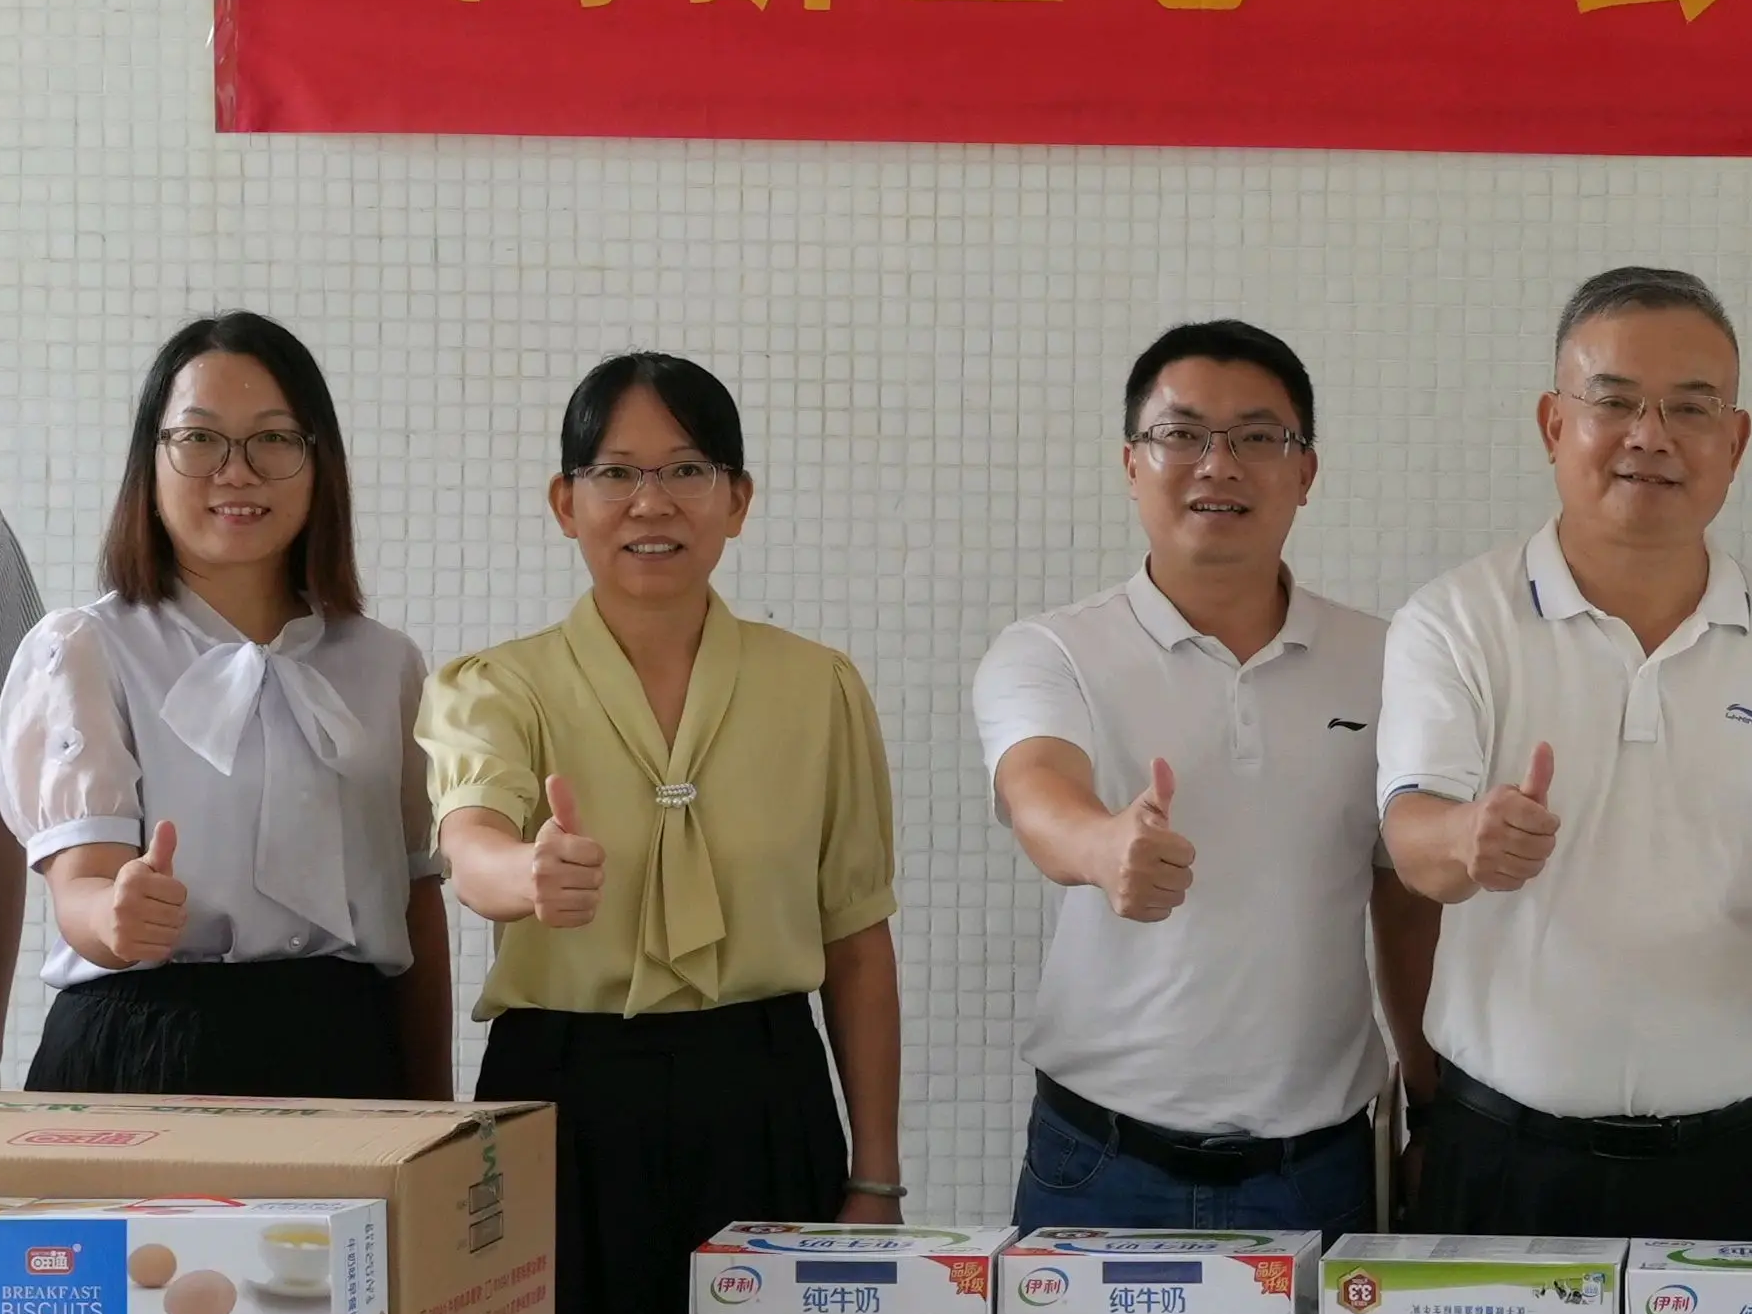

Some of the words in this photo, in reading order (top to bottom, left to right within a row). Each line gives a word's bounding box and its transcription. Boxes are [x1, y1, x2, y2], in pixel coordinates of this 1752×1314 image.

[1, 1284, 101, 1302] BREAKFAST
[718, 1278, 754, 1293] 伊利
[803, 1287, 880, 1313] 纯牛奶
[1109, 1287, 1186, 1314] 纯牛奶
[1654, 1296, 1690, 1311] 伊利
